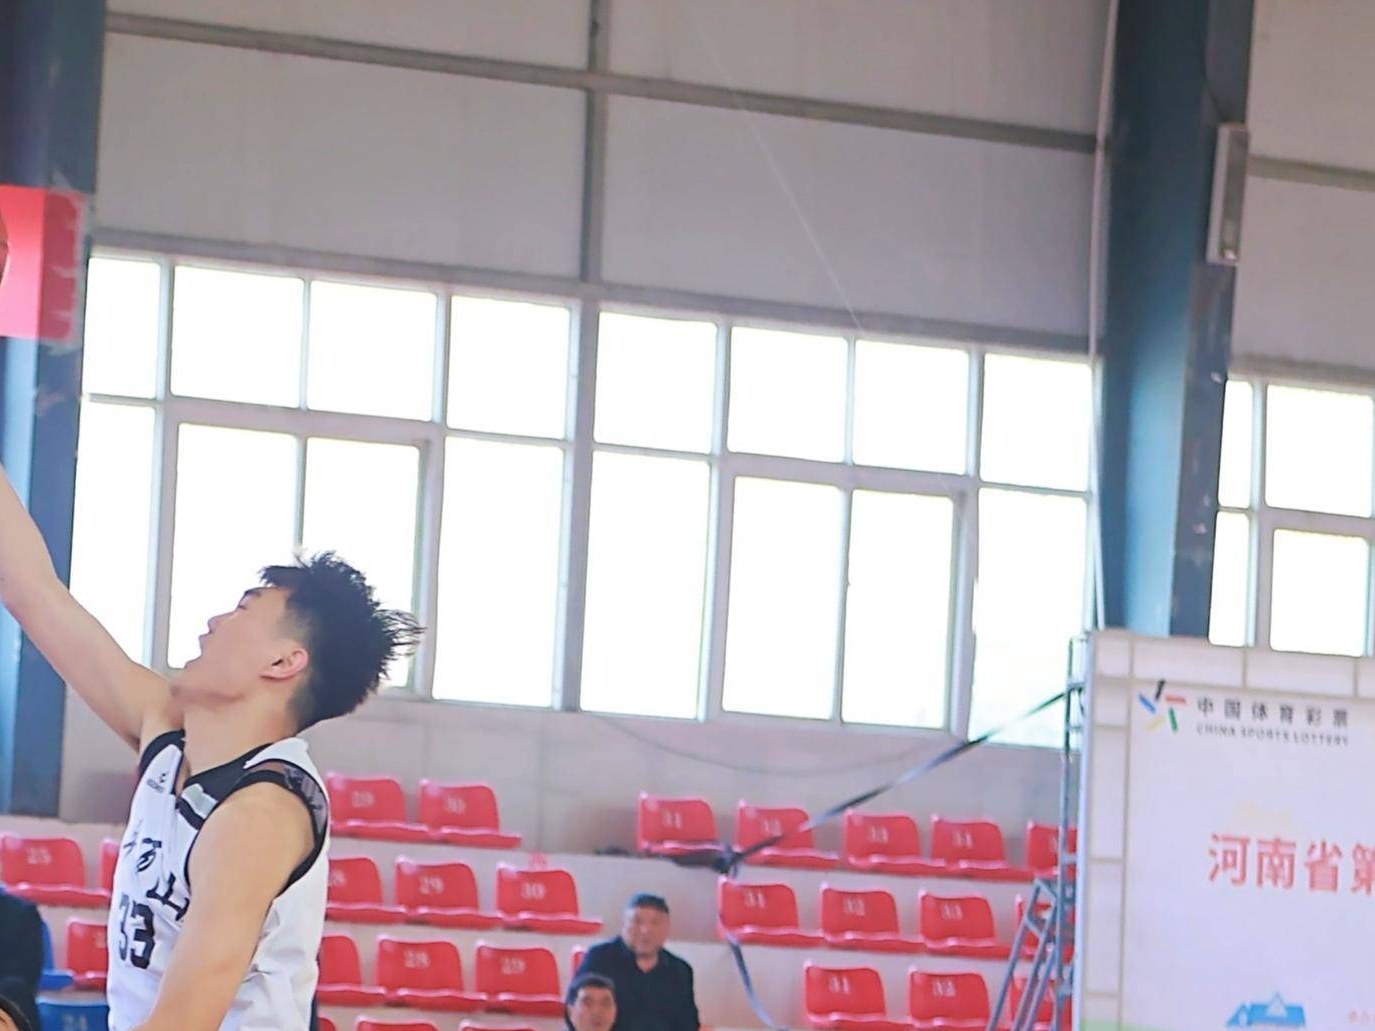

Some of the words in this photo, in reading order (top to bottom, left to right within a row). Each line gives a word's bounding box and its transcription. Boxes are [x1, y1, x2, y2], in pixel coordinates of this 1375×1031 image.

[1197, 696, 1348, 728] 中国体育彩票
[1196, 724, 1236, 738] CHINA
[1241, 727, 1290, 743] SPORTS
[1293, 731, 1348, 747] LOTTERY
[1208, 833, 1375, 895] 河南省第
